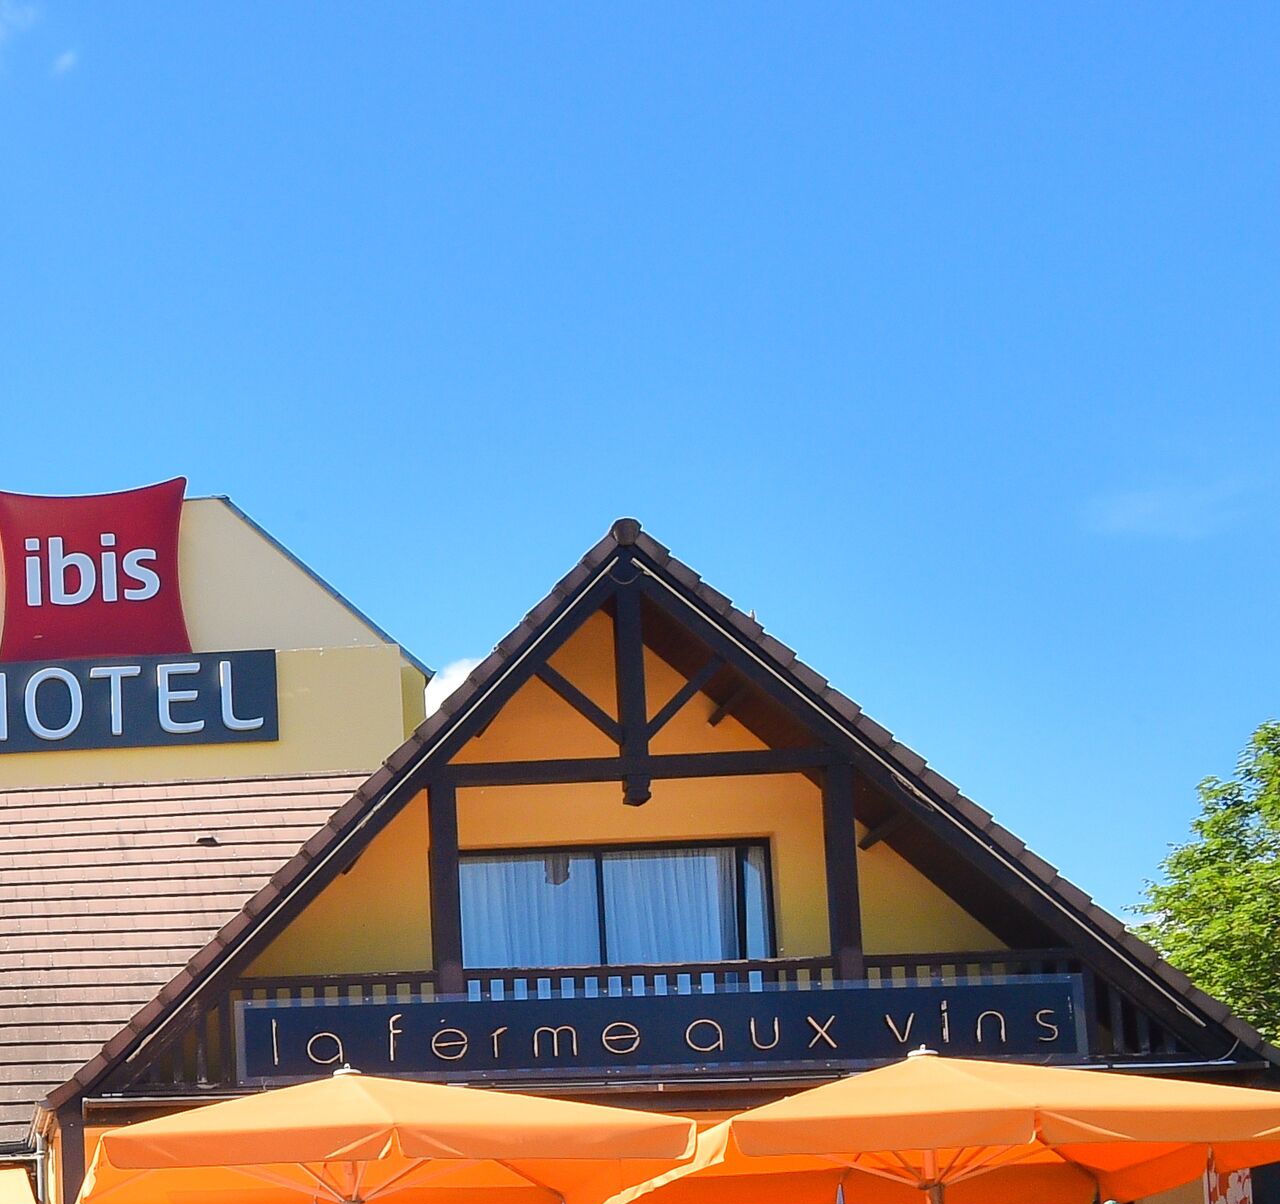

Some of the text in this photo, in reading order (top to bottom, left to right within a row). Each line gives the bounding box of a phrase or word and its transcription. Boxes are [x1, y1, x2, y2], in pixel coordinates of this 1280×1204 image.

[24, 532, 162, 608] ibis
[271, 999, 1060, 1066] la ferme aux vins
